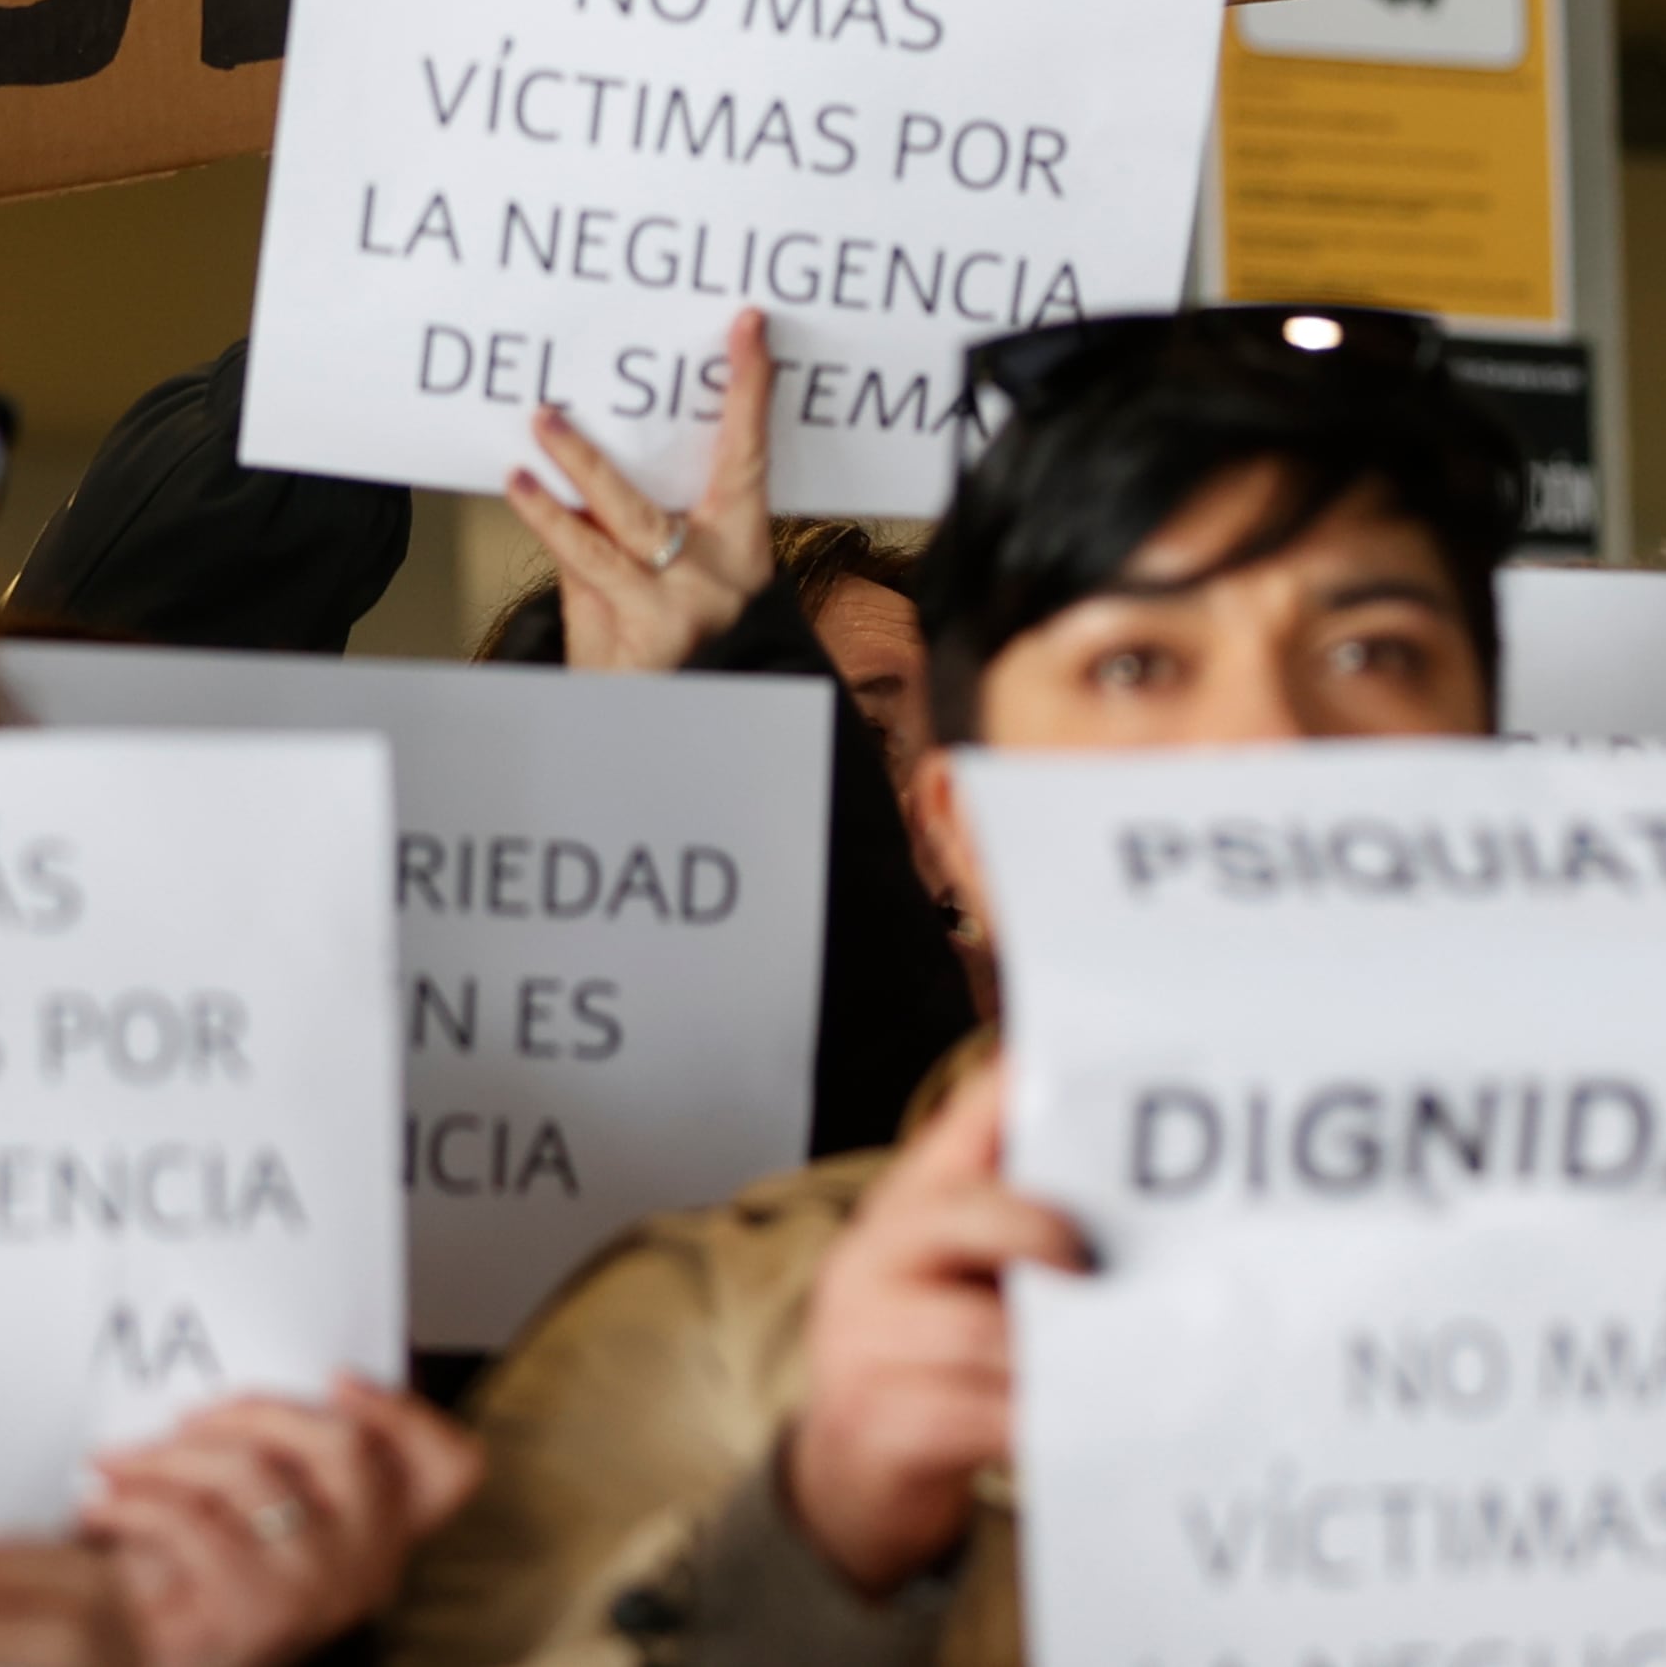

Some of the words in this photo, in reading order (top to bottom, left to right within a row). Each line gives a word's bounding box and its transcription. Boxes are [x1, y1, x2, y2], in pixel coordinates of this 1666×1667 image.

[422, 36, 859, 176] VÍCTIMAS
[894, 112, 1069, 199] POR
[356, 183, 462, 264] LA
[498, 198, 1086, 333] NEGLIGENCIA
[417, 323, 572, 413] DEL
[392, 831, 741, 926] RIEDAD
[34, 985, 254, 1092] POR
[513, 976, 625, 1061] ES
[1343, 1316, 1515, 1422] NO
